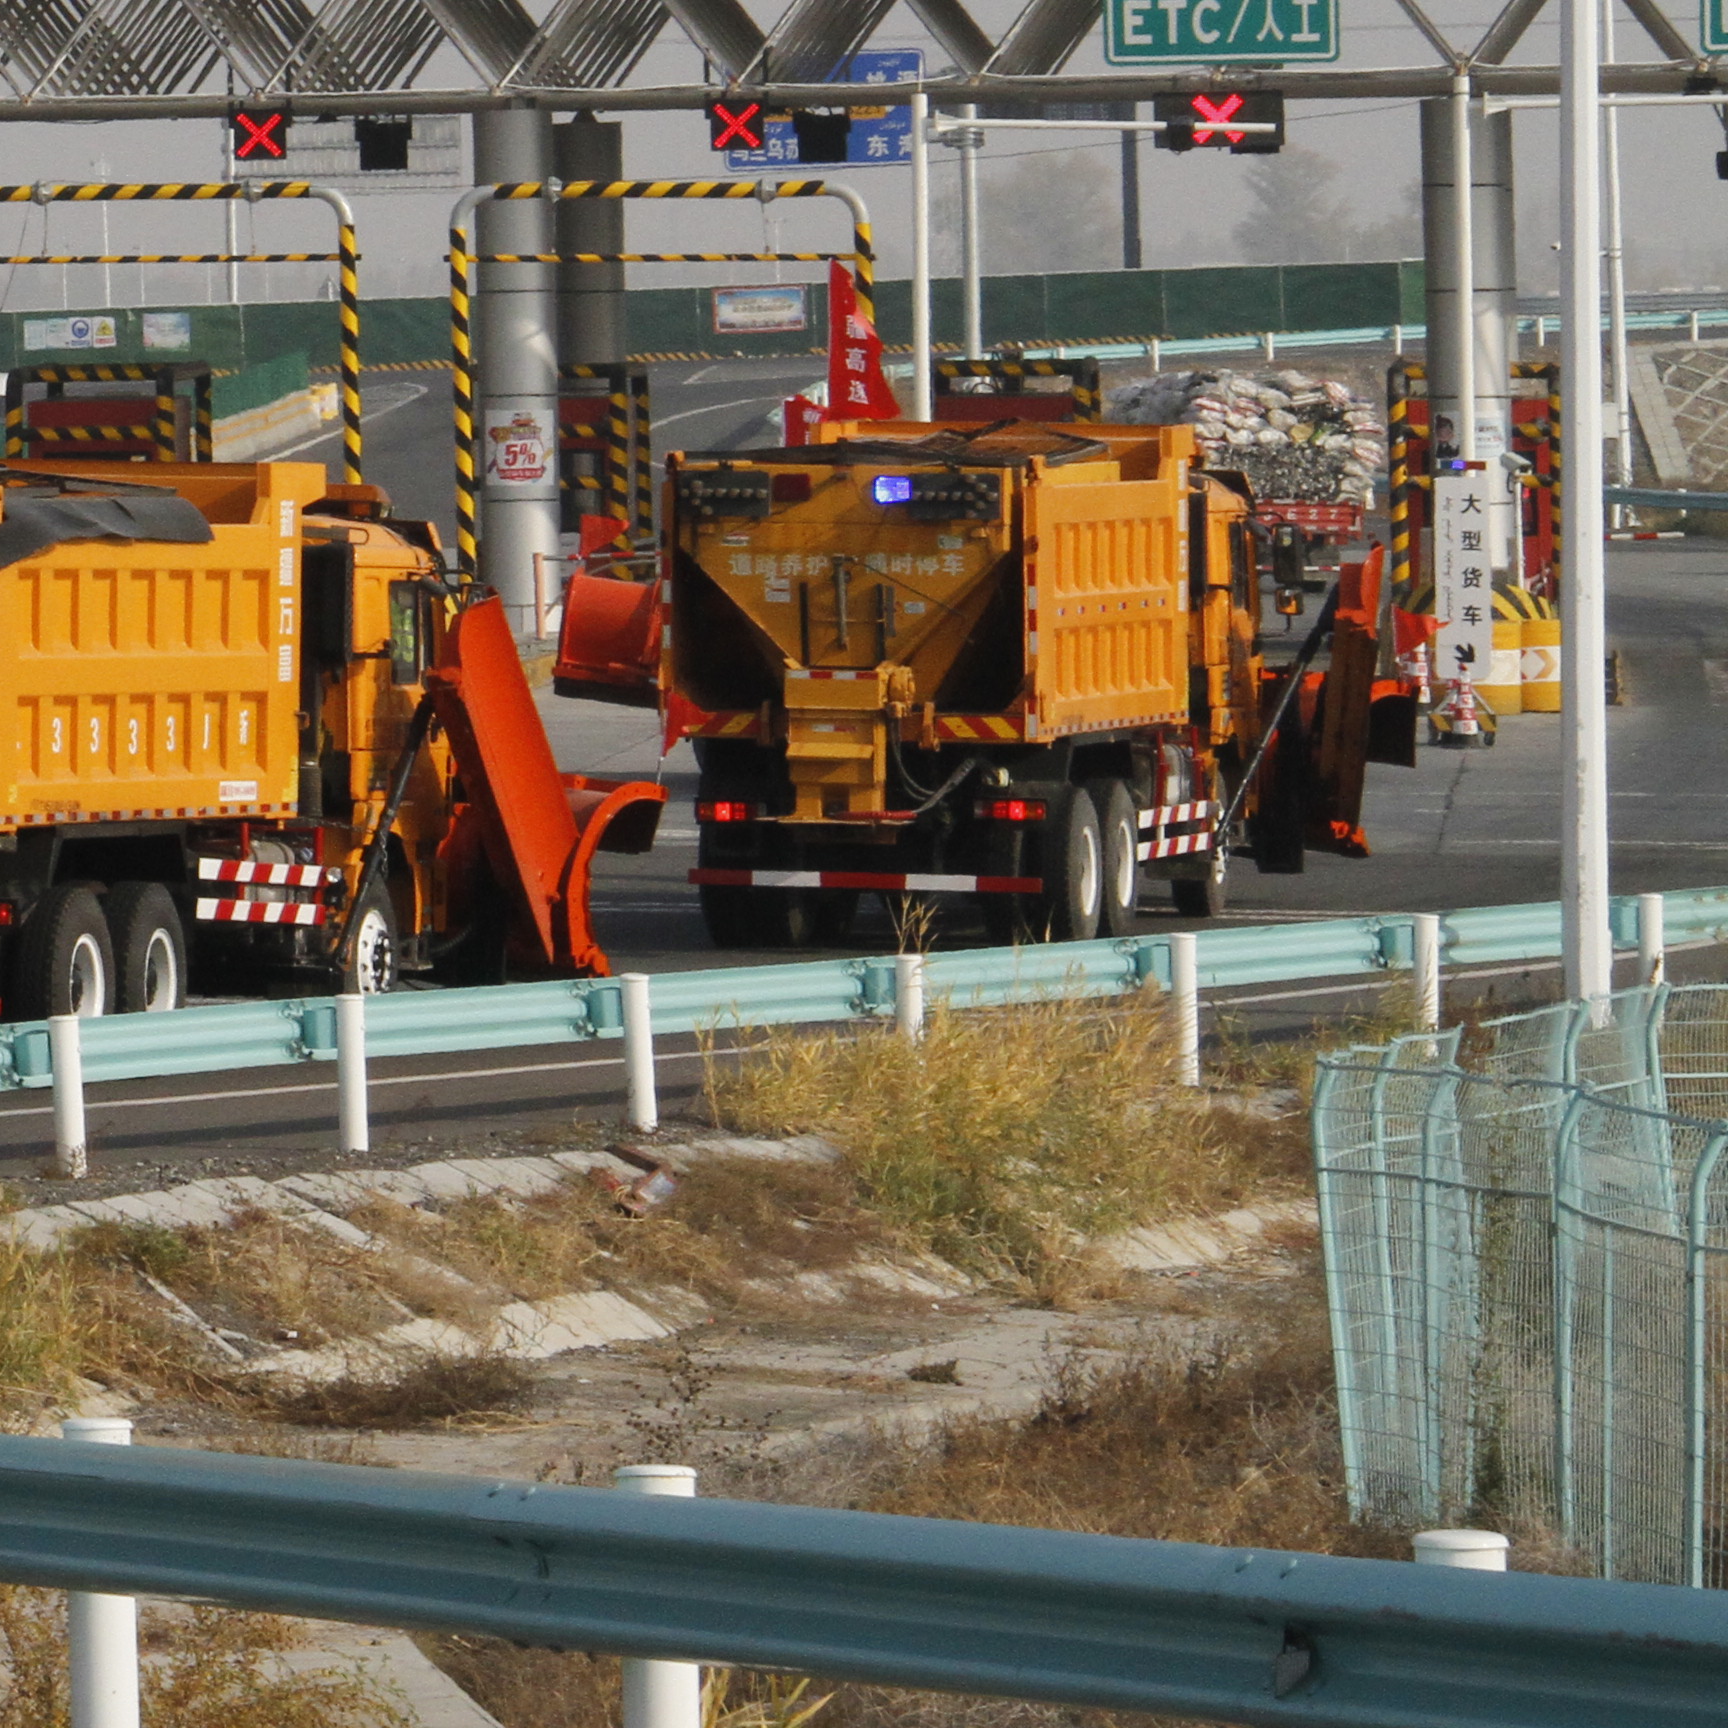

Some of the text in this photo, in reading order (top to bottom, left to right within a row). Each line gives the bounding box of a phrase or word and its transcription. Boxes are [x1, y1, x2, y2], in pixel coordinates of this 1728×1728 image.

[504, 442, 537, 467] 5%
[1460, 493, 1484, 626] 大型货车
